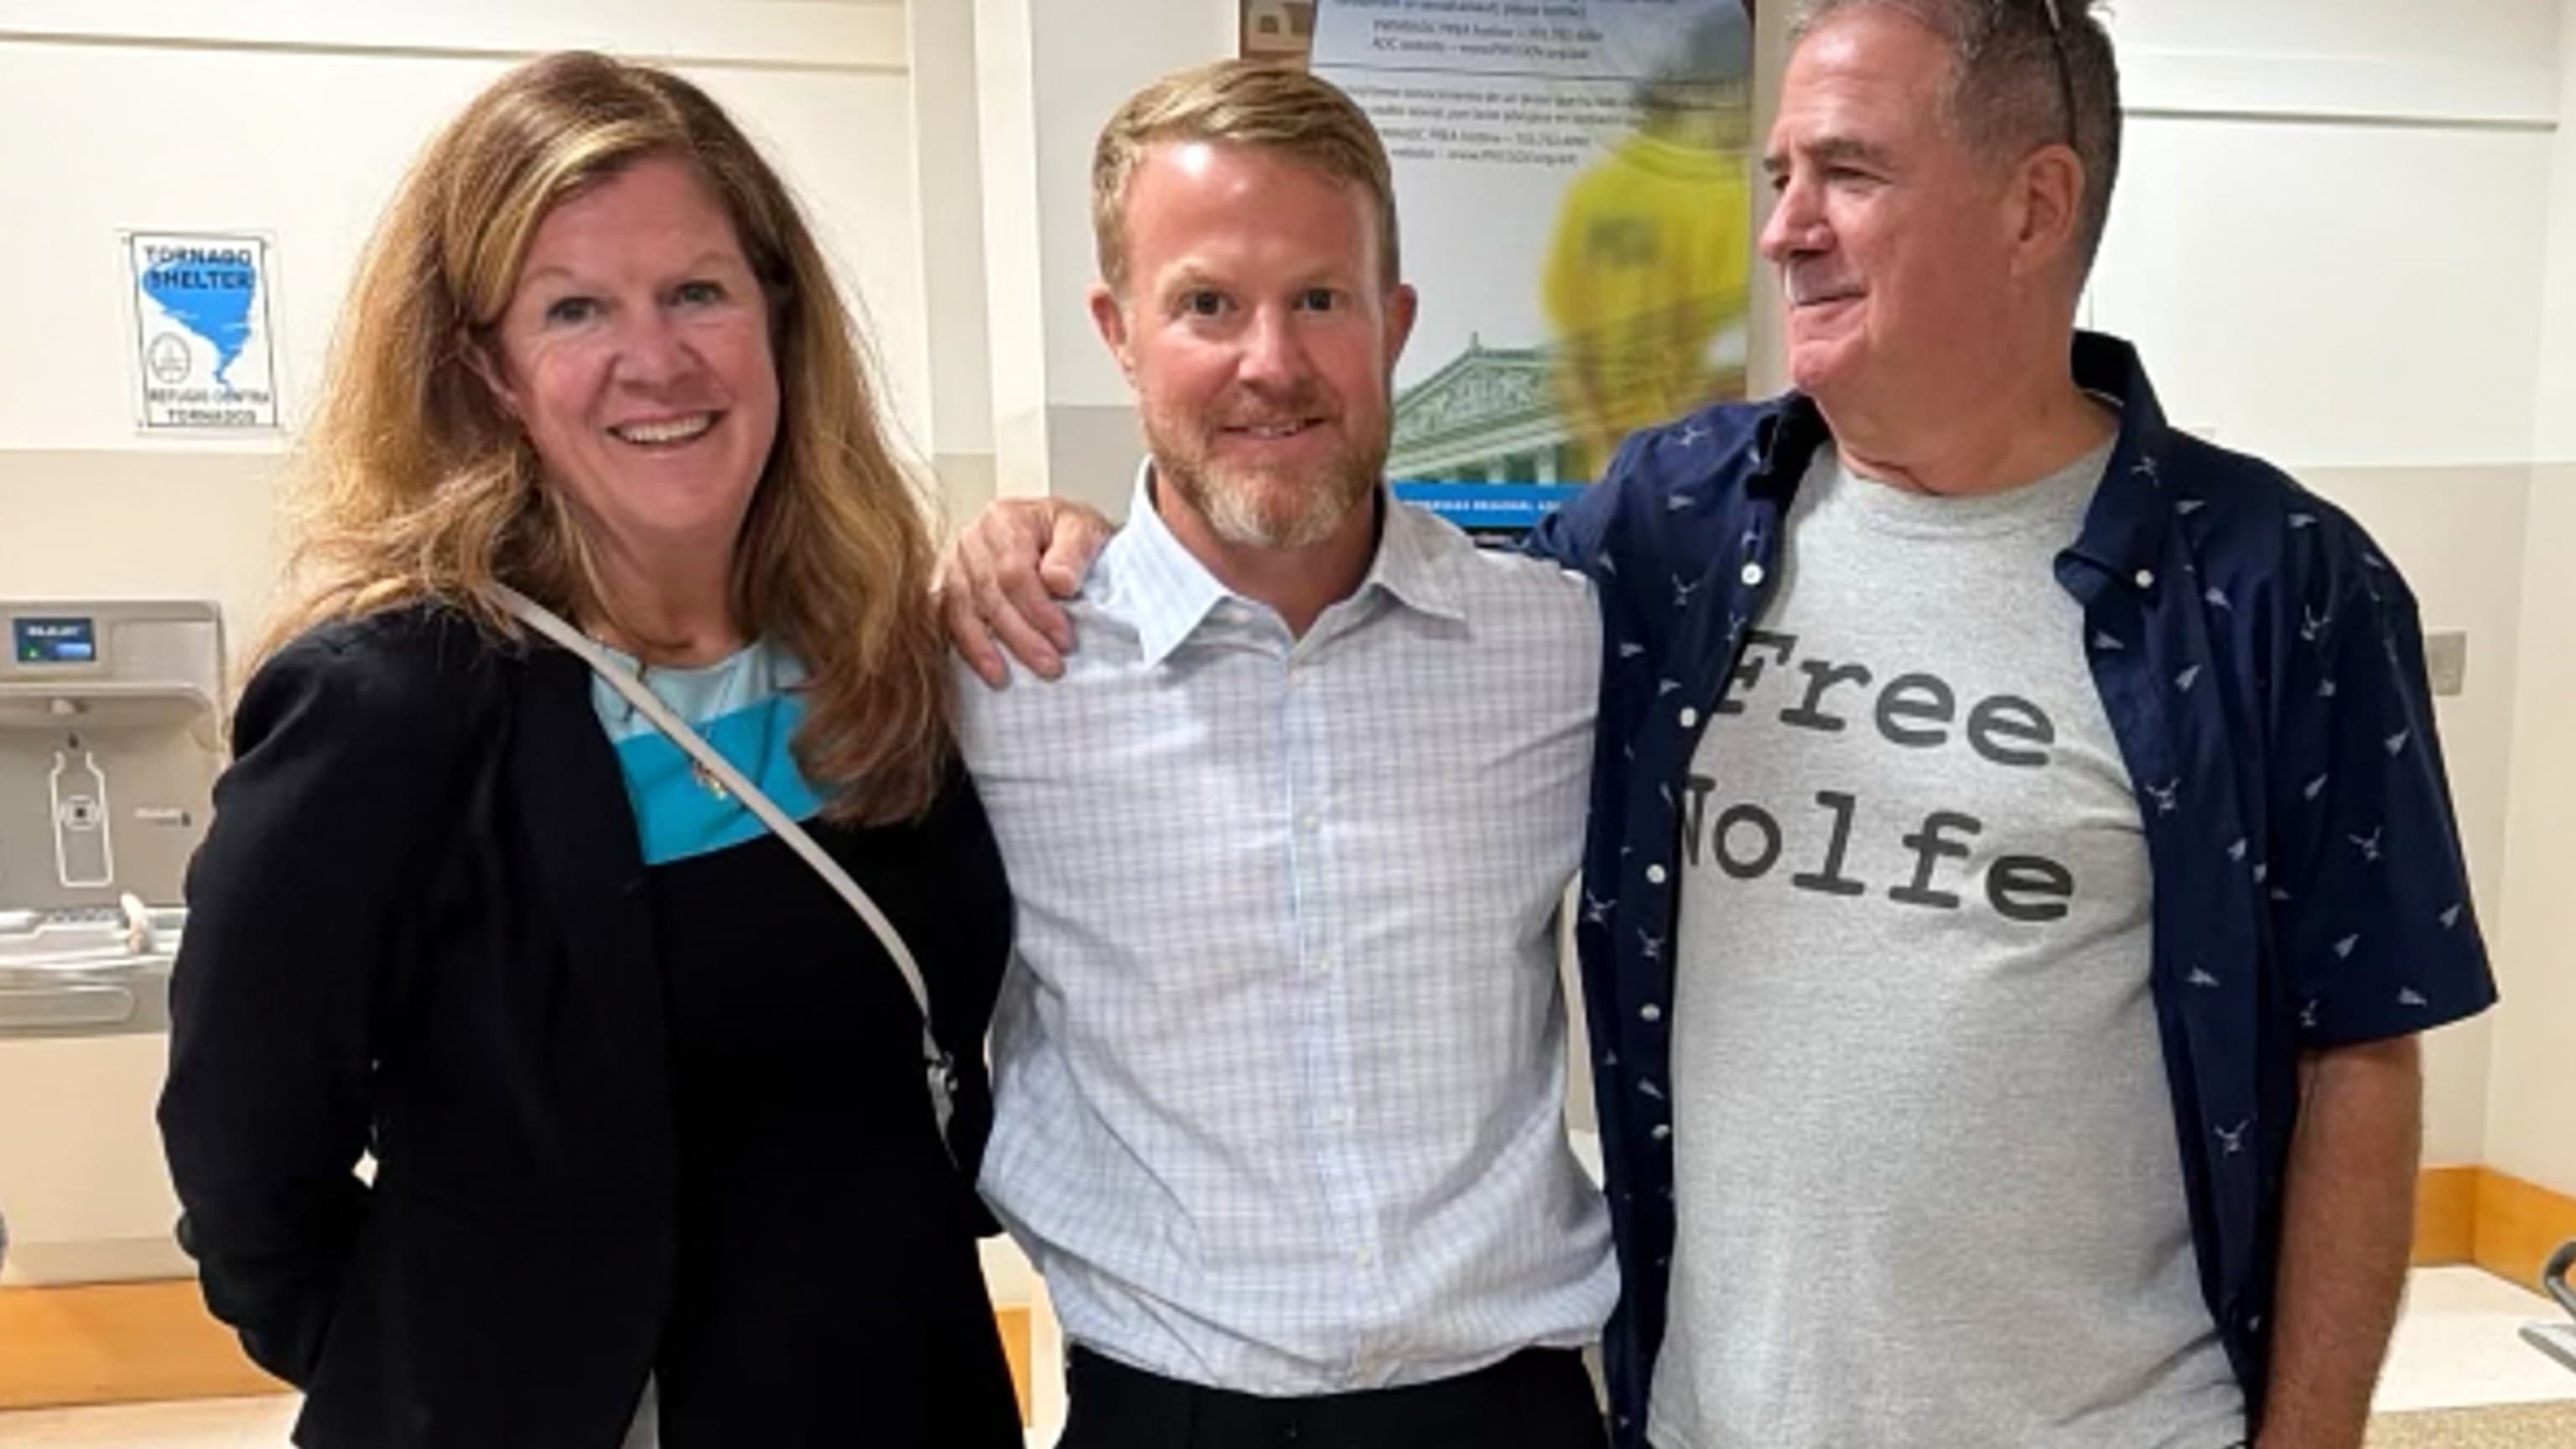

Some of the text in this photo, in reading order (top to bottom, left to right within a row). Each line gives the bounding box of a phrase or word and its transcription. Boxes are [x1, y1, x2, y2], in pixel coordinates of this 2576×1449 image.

[143, 244, 252, 266] TORNADO
[150, 269, 253, 289] SHELTER
[1712, 629, 2055, 767] Free
